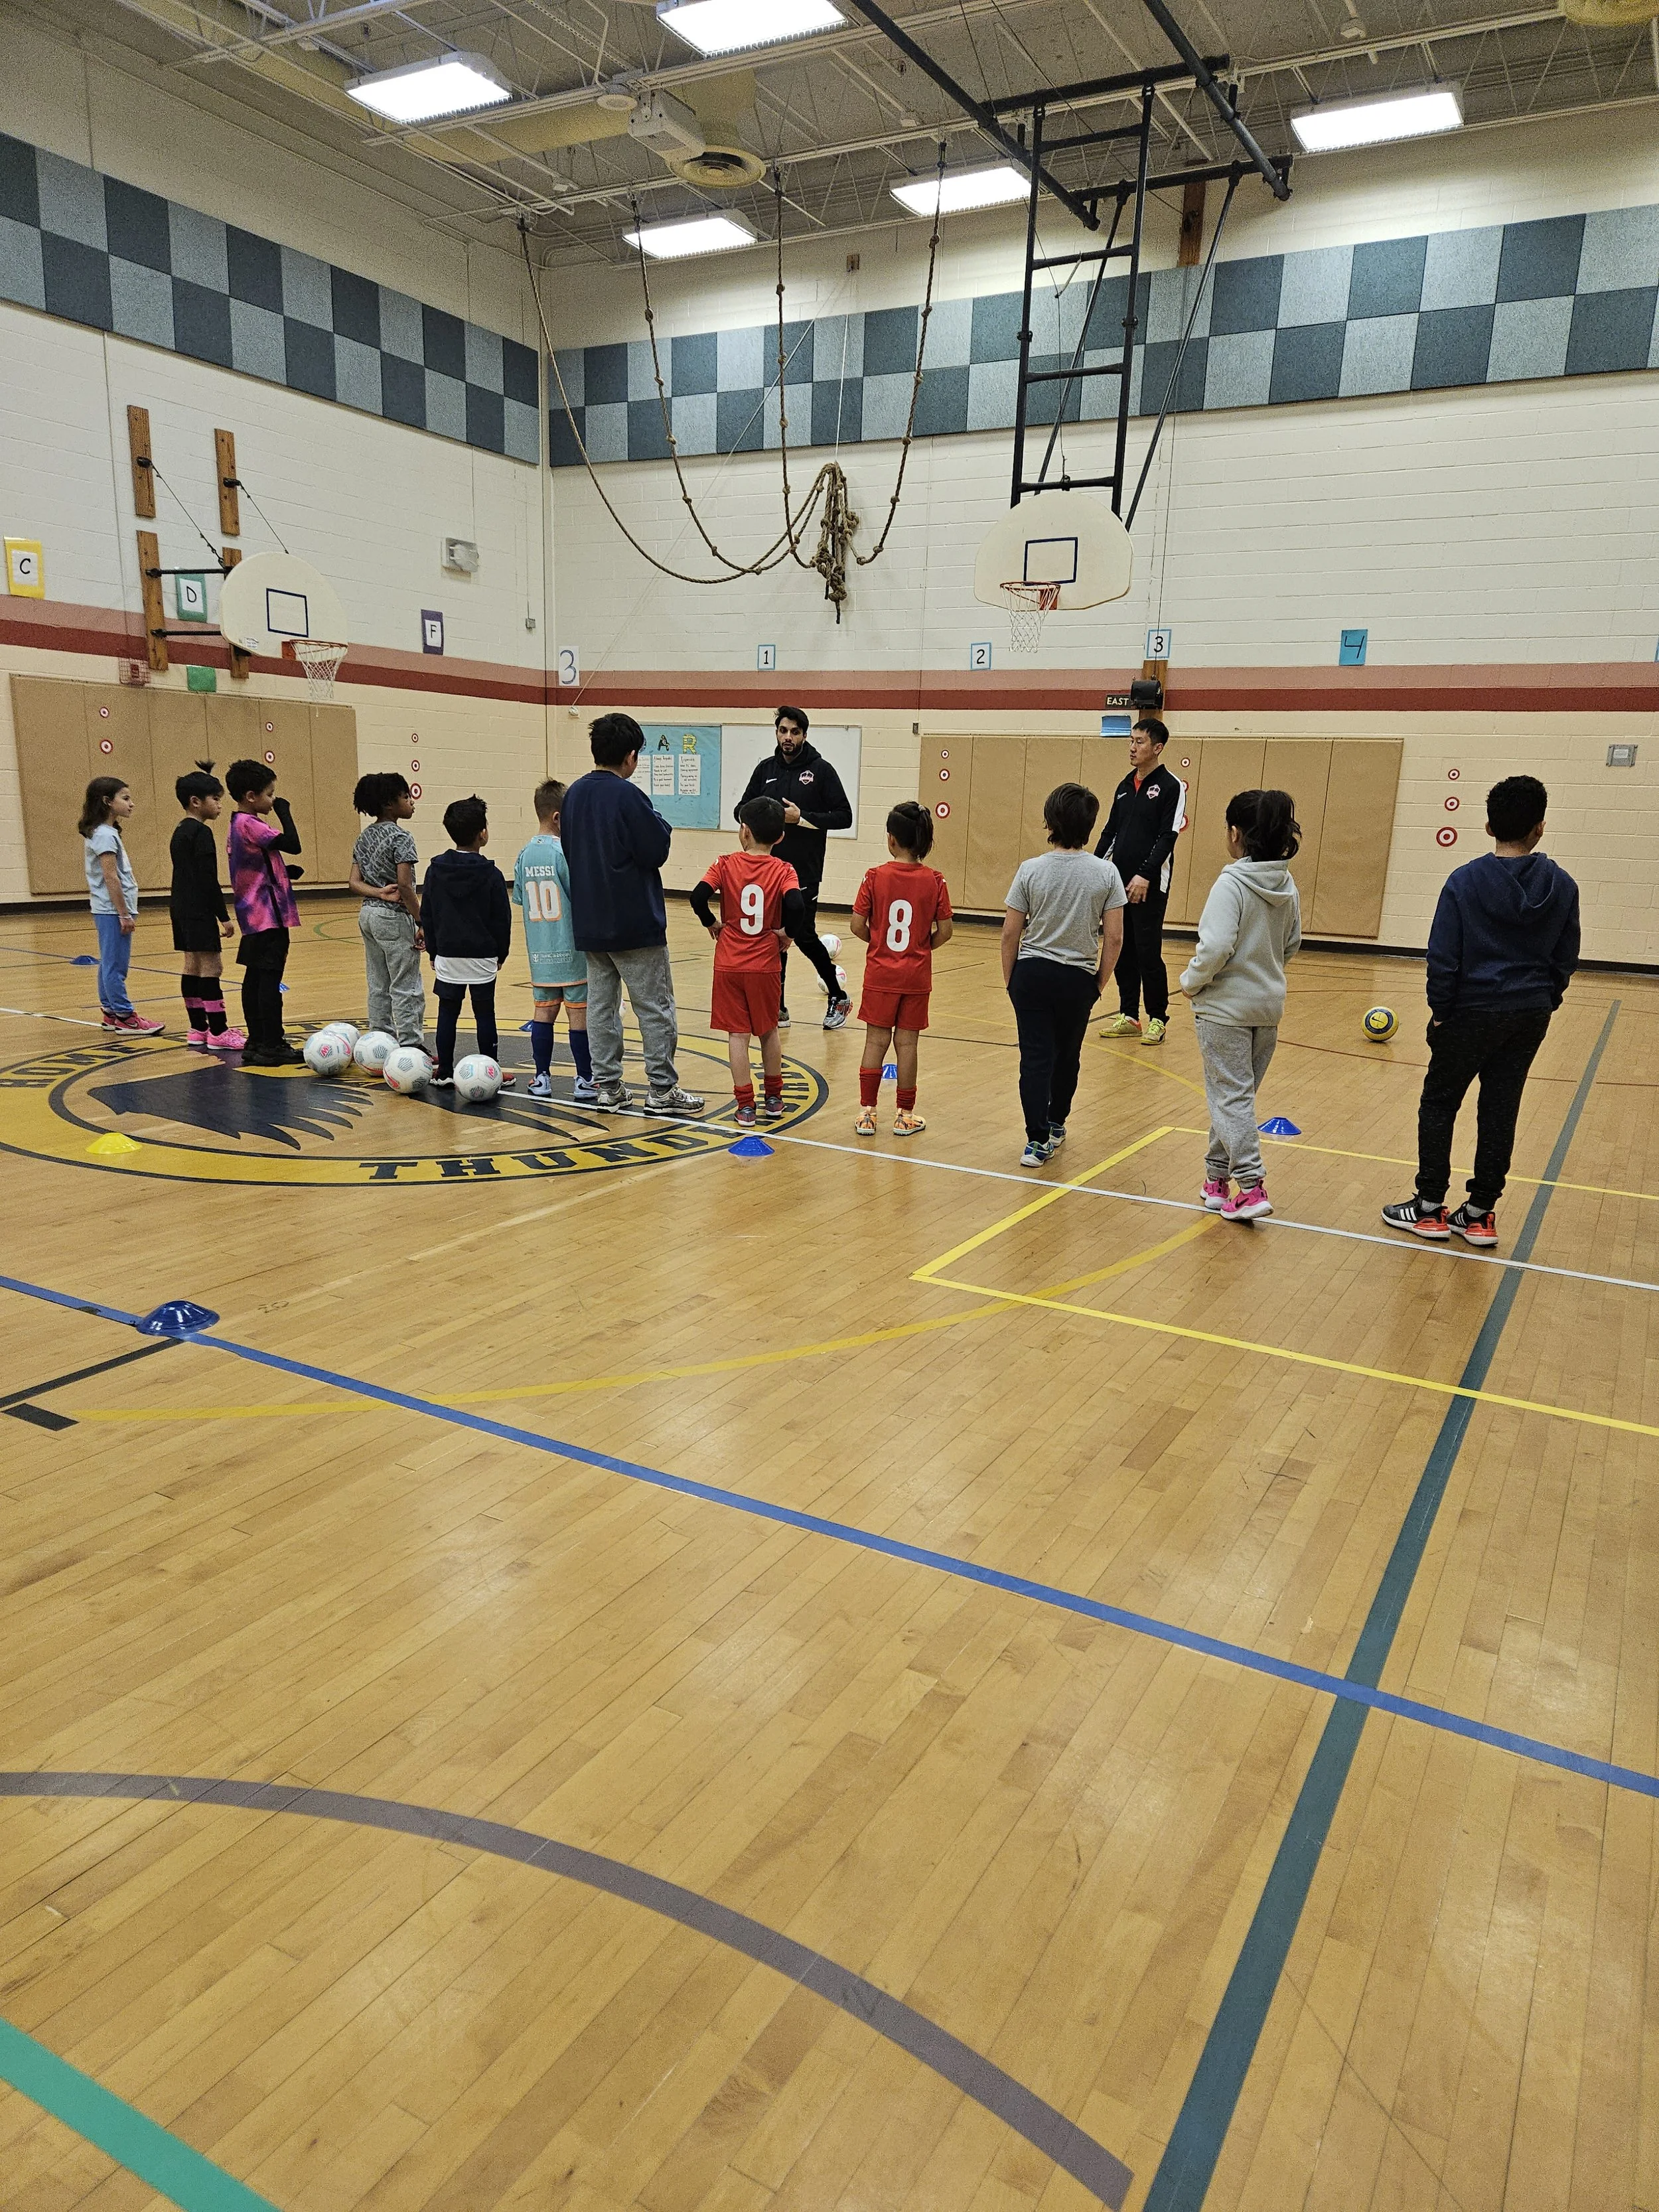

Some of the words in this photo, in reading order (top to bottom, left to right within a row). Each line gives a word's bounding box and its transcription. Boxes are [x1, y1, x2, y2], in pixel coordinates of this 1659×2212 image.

[19, 557, 31, 575] C
[186, 585, 197, 603] D
[430, 624, 437, 638] F
[1153, 636, 1164, 653] 3
[1344, 635, 1365, 659] 4
[763, 650, 769, 665] 1
[976, 648, 985, 664] 2
[559, 649, 577, 685] 3
[1106, 696, 1129, 706] EAST
[657, 734, 670, 751] A
[682, 733, 697, 755] R
[525, 865, 555, 877] MESSI
[525, 880, 562, 921] 10
[740, 883, 764, 935] 9
[886, 899, 913, 952] 8
[0, 1045, 155, 1088] HOME
